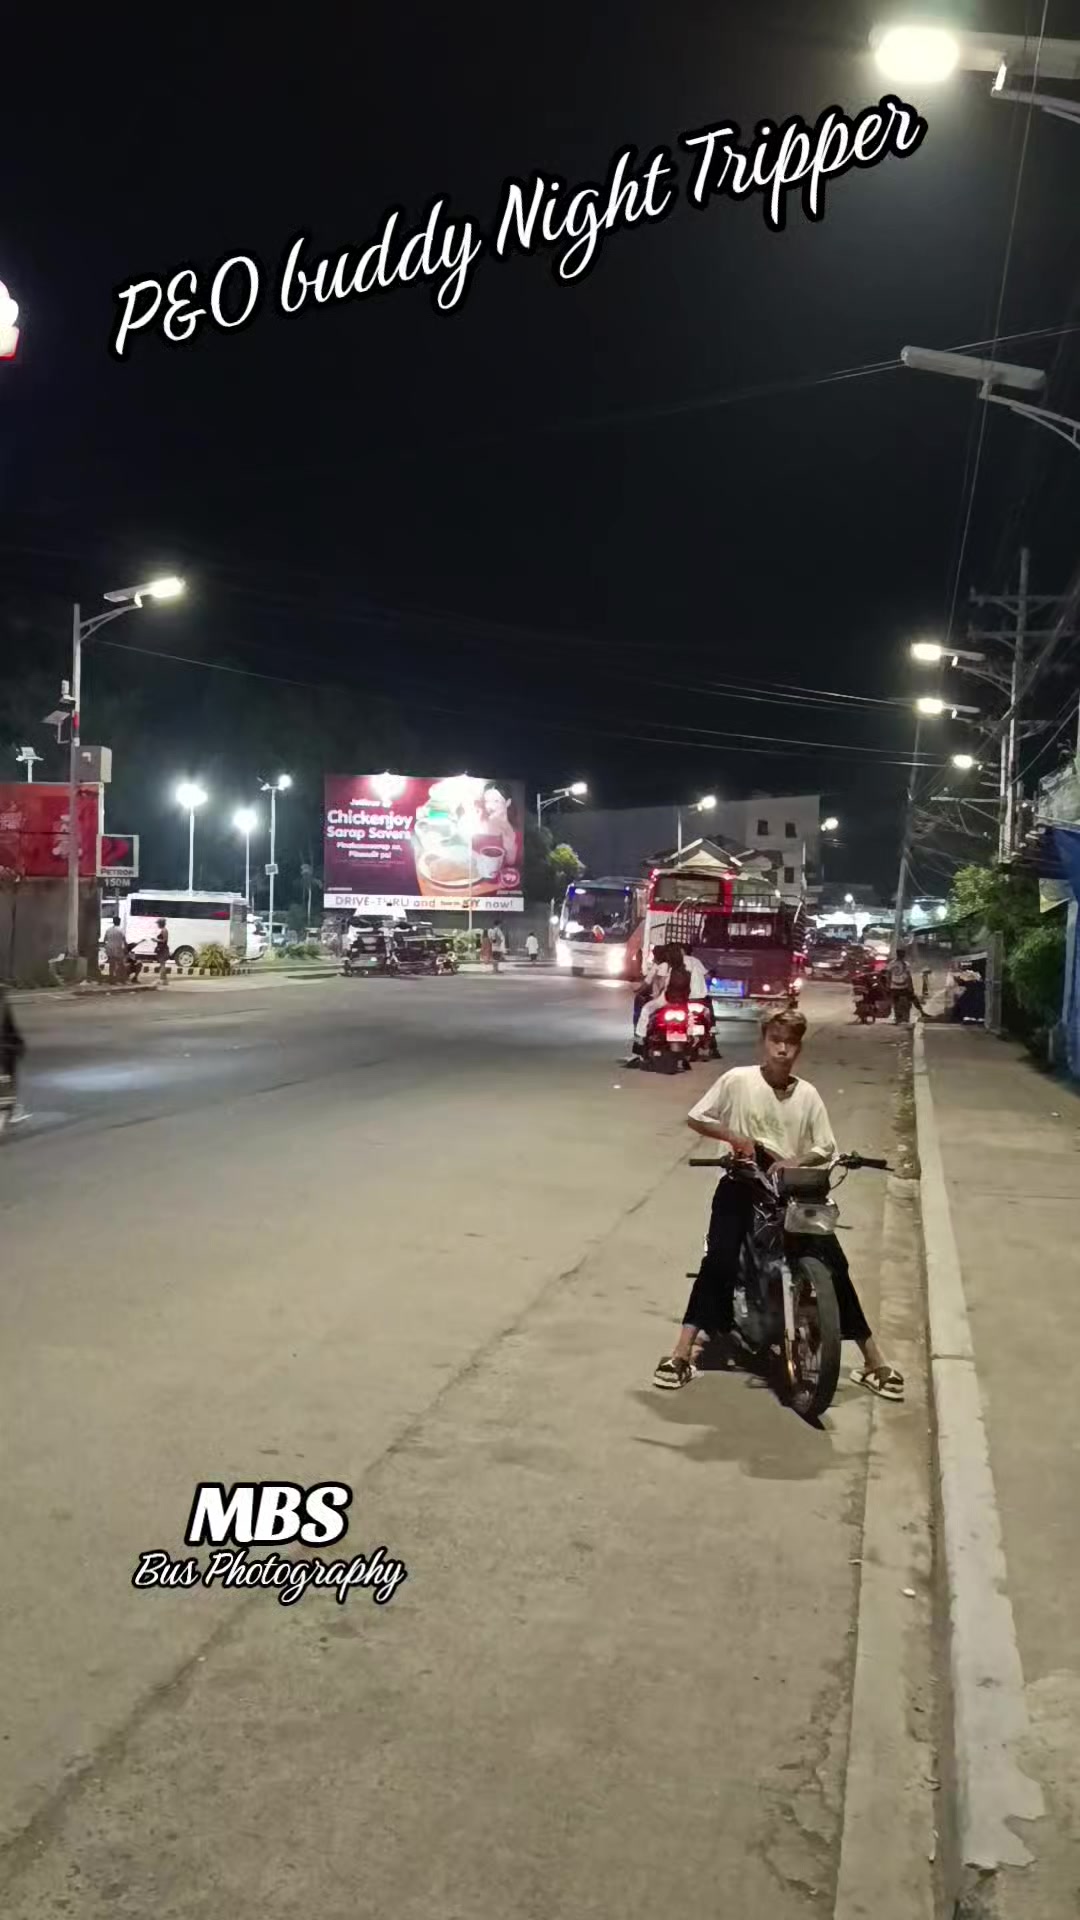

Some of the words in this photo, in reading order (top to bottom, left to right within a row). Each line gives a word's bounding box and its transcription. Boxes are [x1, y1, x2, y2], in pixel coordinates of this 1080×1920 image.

[327, 809, 413, 829] Chickenjoy
[326, 825, 366, 841] Sarap
[104, 878, 131, 887] 150M
[413, 898, 435, 908] and
[485, 899, 513, 909] now!
